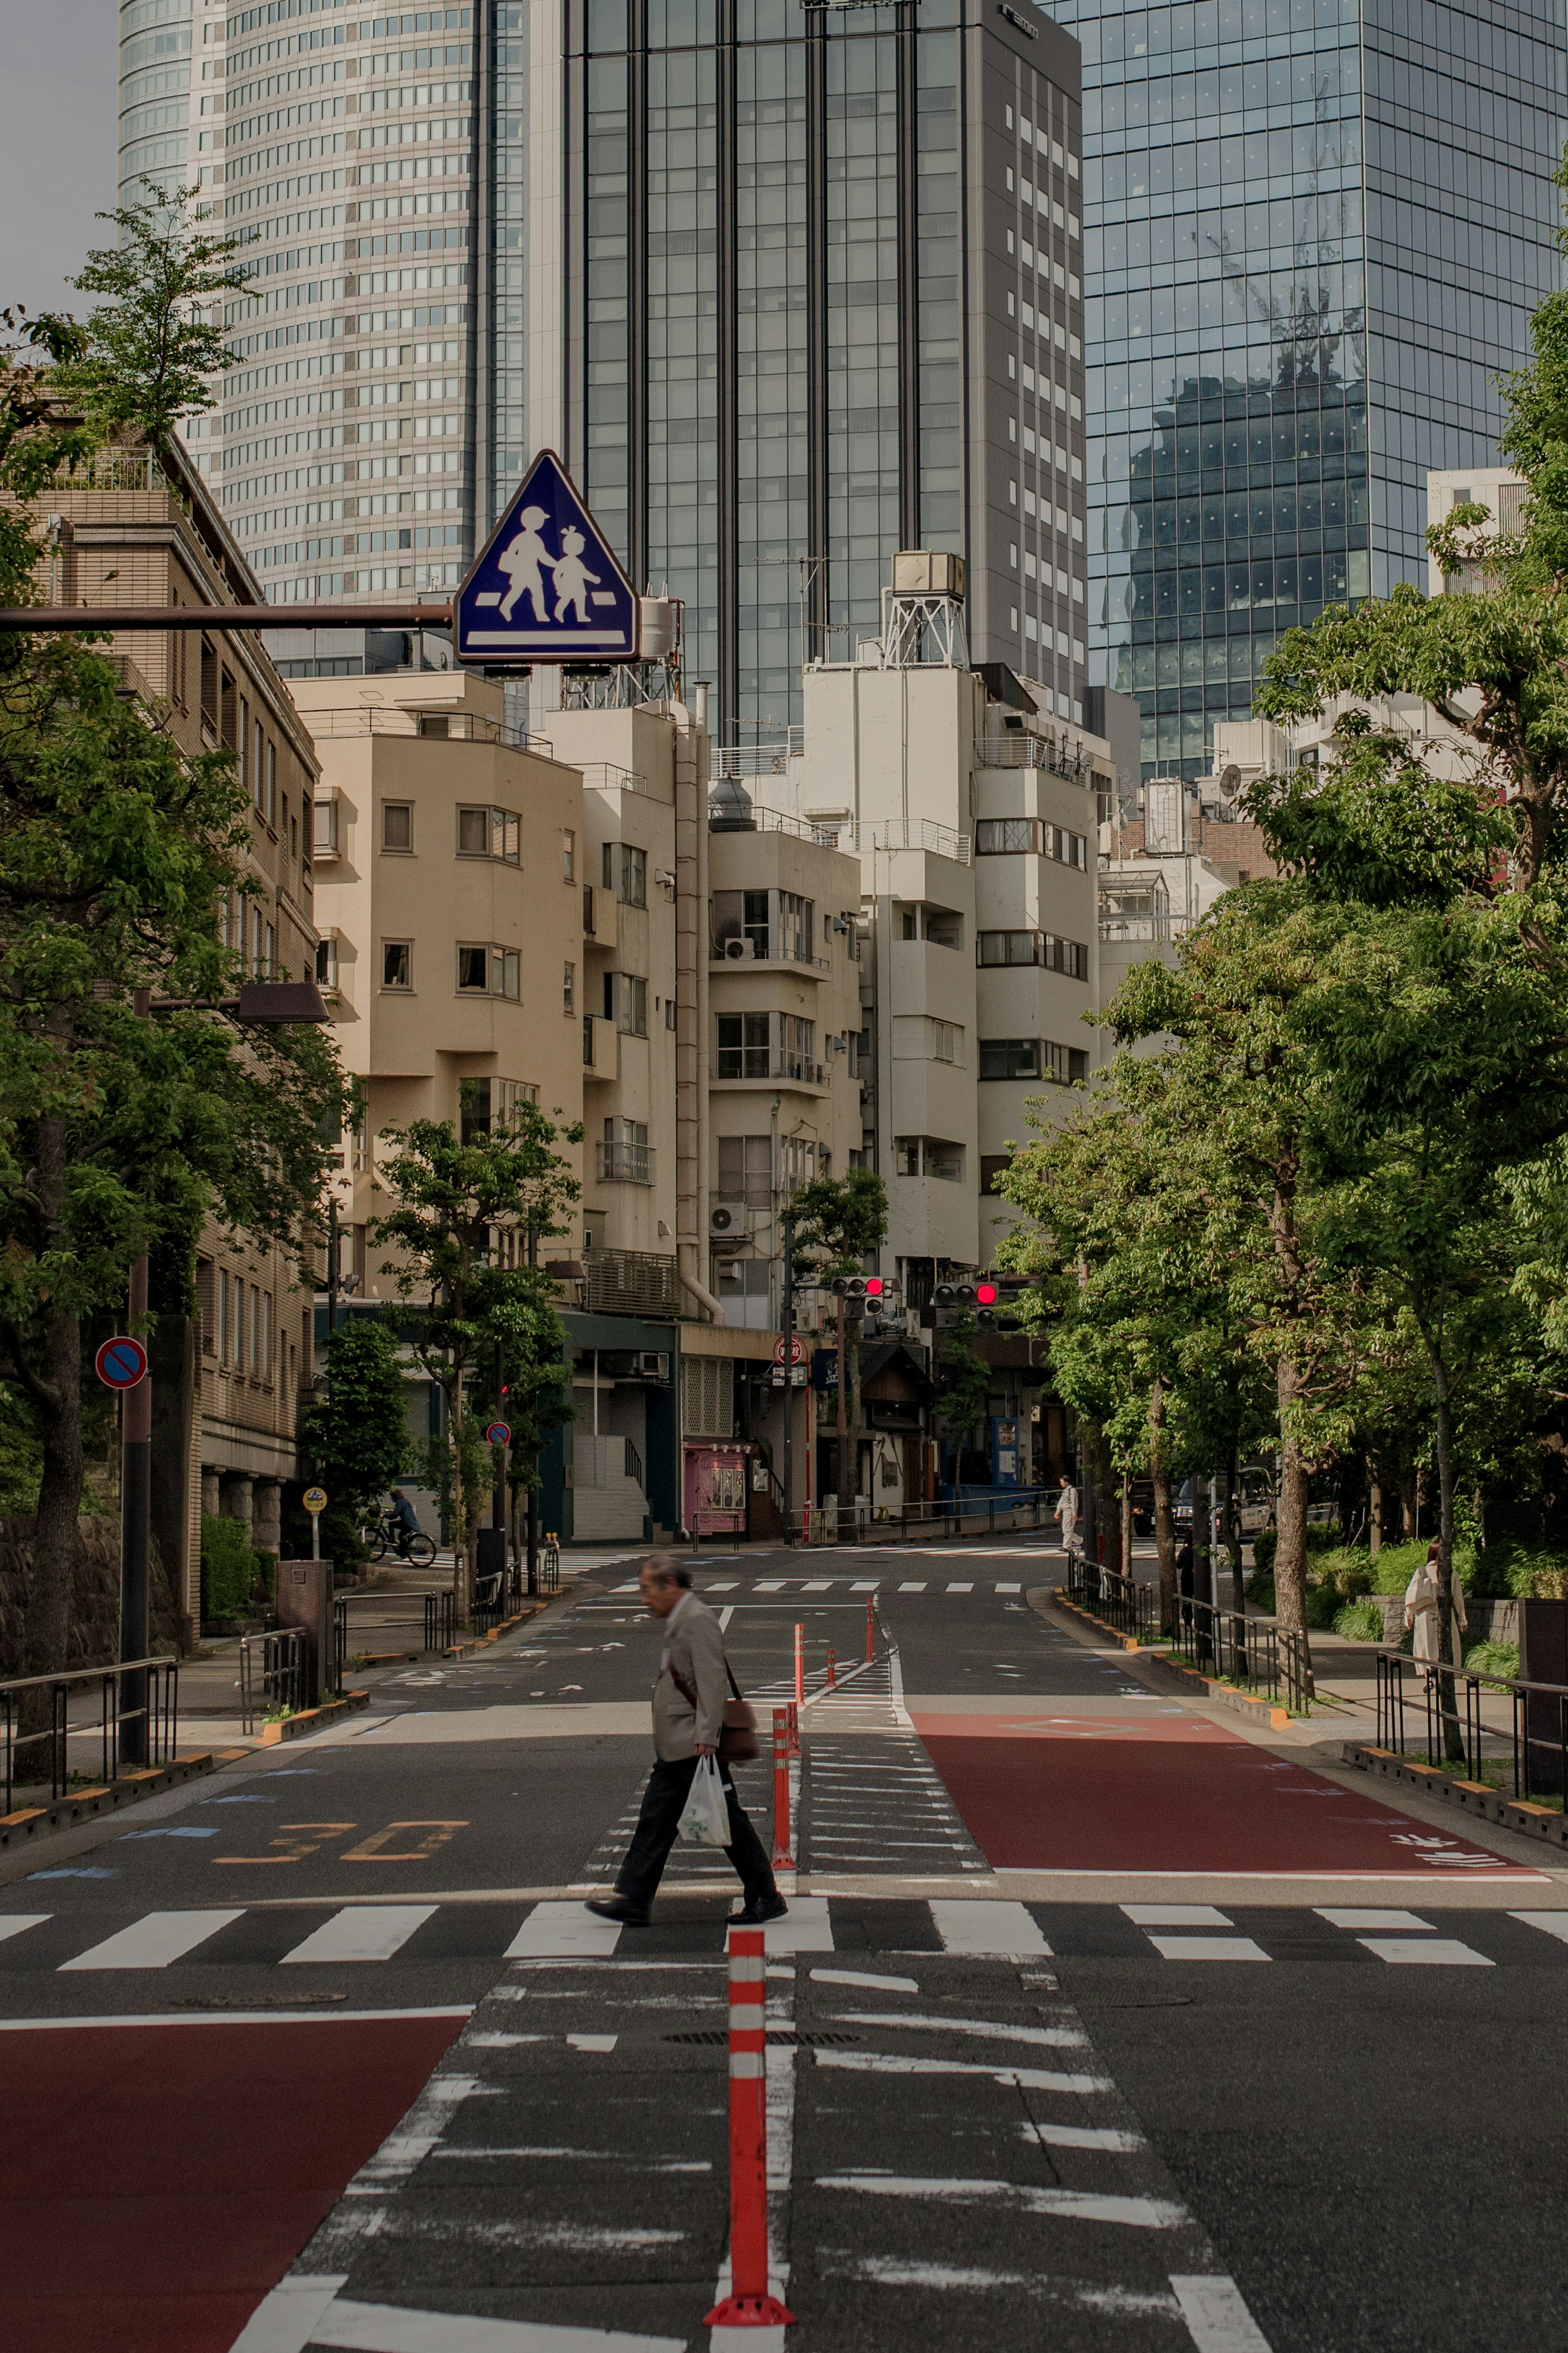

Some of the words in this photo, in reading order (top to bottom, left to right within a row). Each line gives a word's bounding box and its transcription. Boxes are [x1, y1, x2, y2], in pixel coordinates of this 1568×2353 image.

[1002, 3, 1038, 39] remm
[779, 1346, 800, 1356] 消栓
[211, 1820, 471, 1864] 30
